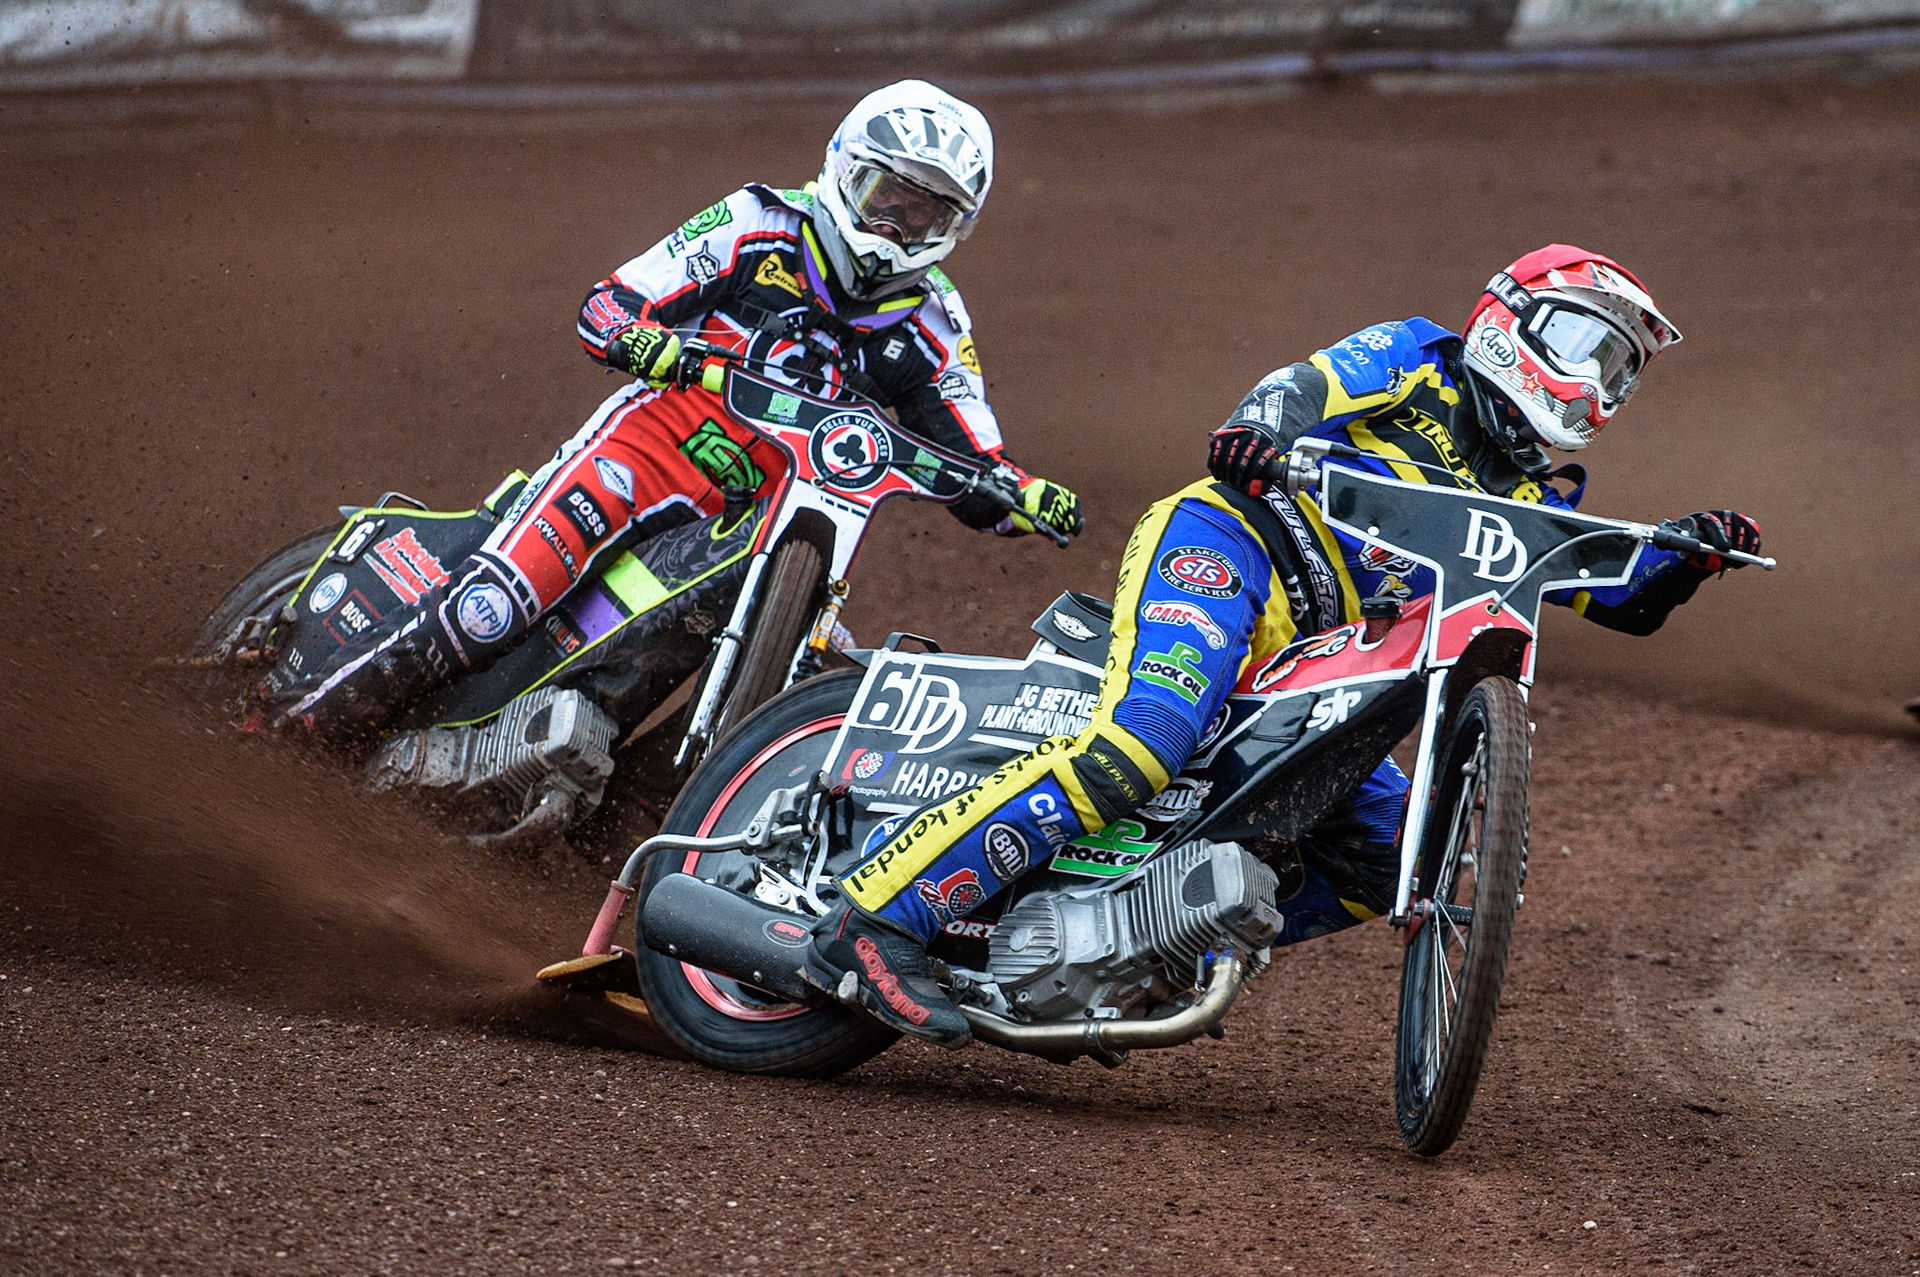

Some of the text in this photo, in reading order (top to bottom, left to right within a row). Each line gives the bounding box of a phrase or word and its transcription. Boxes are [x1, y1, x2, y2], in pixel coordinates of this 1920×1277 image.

[882, 338, 906, 361] 6
[1482, 331, 1514, 363] Arai
[820, 416, 889, 457] BELLE VUE ACES
[568, 491, 606, 537] BOSS
[338, 520, 376, 557] 6
[1177, 558, 1222, 582] STS
[1178, 548, 1239, 578] STAKEFORD
[1161, 567, 1234, 597] TYRE SERVICES
[340, 600, 371, 633] BOSS
[470, 594, 502, 633] ATPI
[1149, 606, 1193, 626] CARS
[857, 660, 917, 729] 6
[1139, 661, 1203, 698] ROCK OIL
[1013, 684, 1100, 718] JG BETHE
[848, 784, 889, 799] Photography
[1108, 768, 1139, 804] PLANT
[849, 808, 949, 893] kendal
[1058, 844, 1120, 867] ROCK
[854, 935, 931, 1026] daytona
